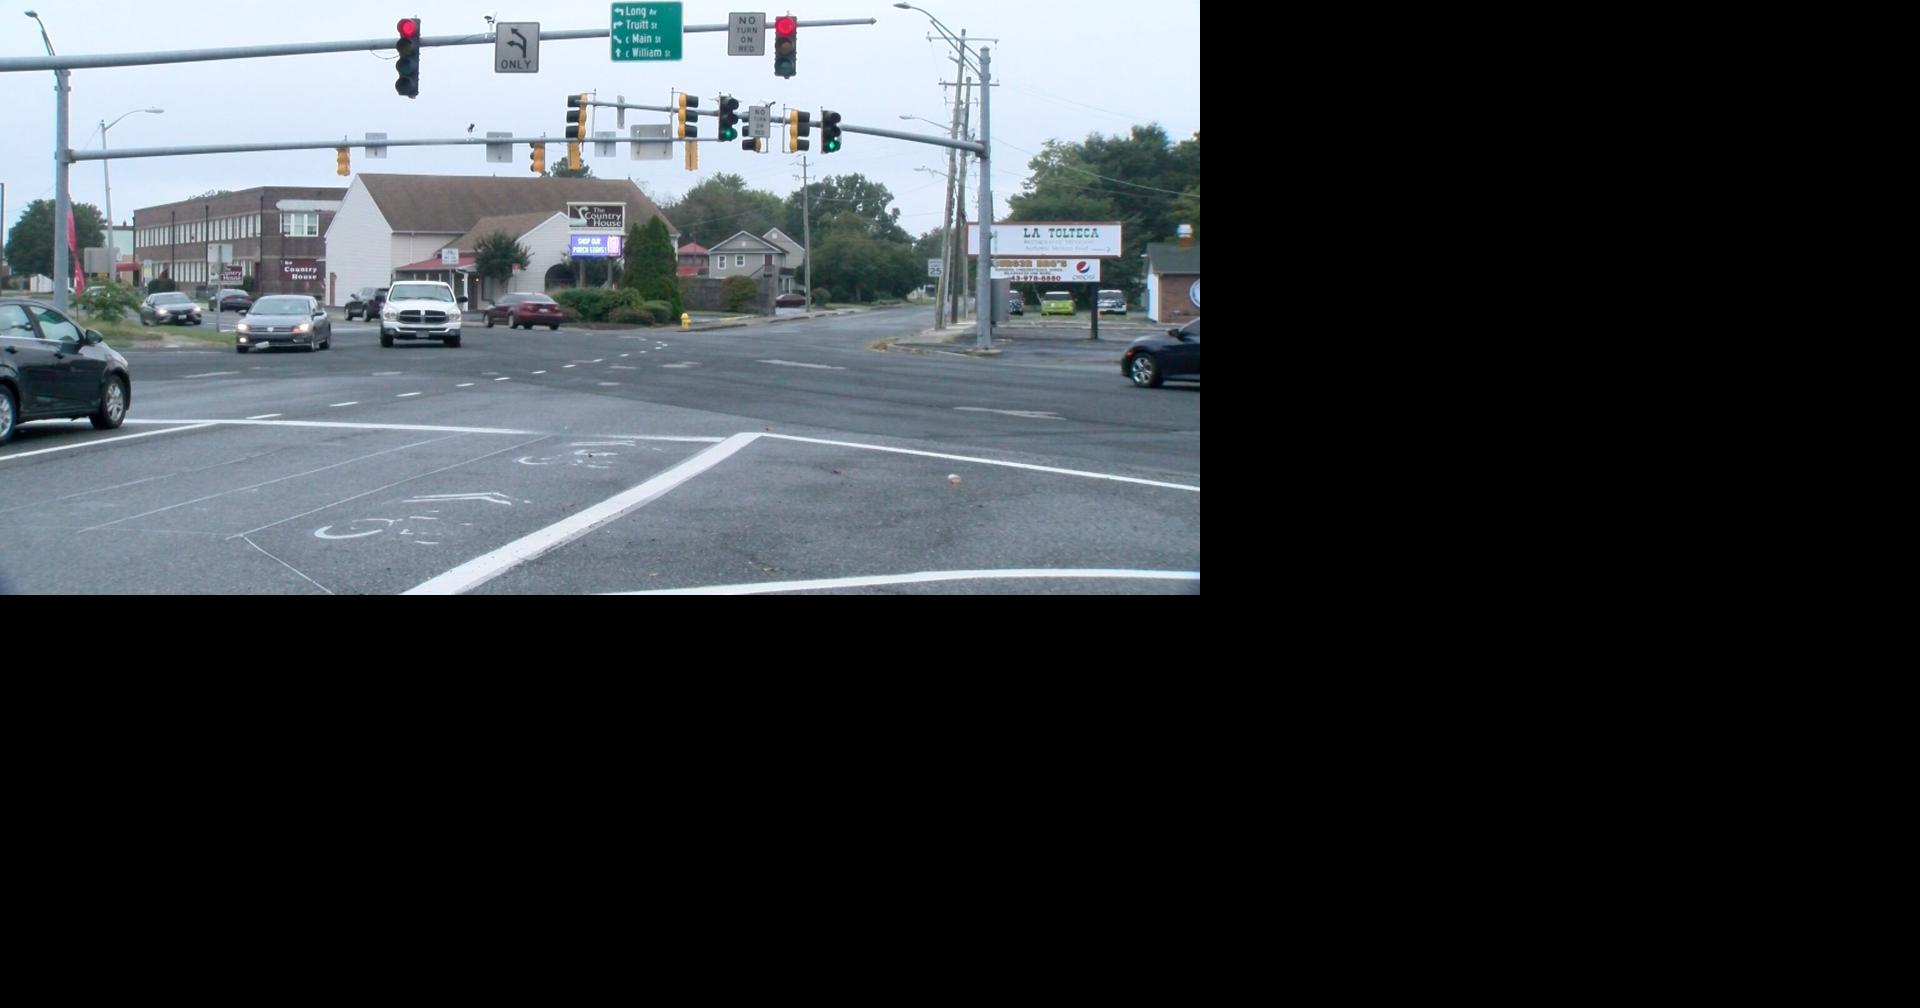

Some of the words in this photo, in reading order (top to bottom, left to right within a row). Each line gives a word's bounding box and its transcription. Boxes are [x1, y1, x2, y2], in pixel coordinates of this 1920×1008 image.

[626, 6, 646, 18] Long
[626, 20, 648, 29] Truitt
[739, 16, 755, 24] NO
[632, 34, 652, 43] Main
[632, 48, 662, 57] William
[501, 60, 532, 69] ONLY
[585, 212, 621, 220] Country
[1024, 228, 1041, 238] LA
[1049, 228, 1099, 238] TOLTECA
[931, 267, 942, 275] 25
